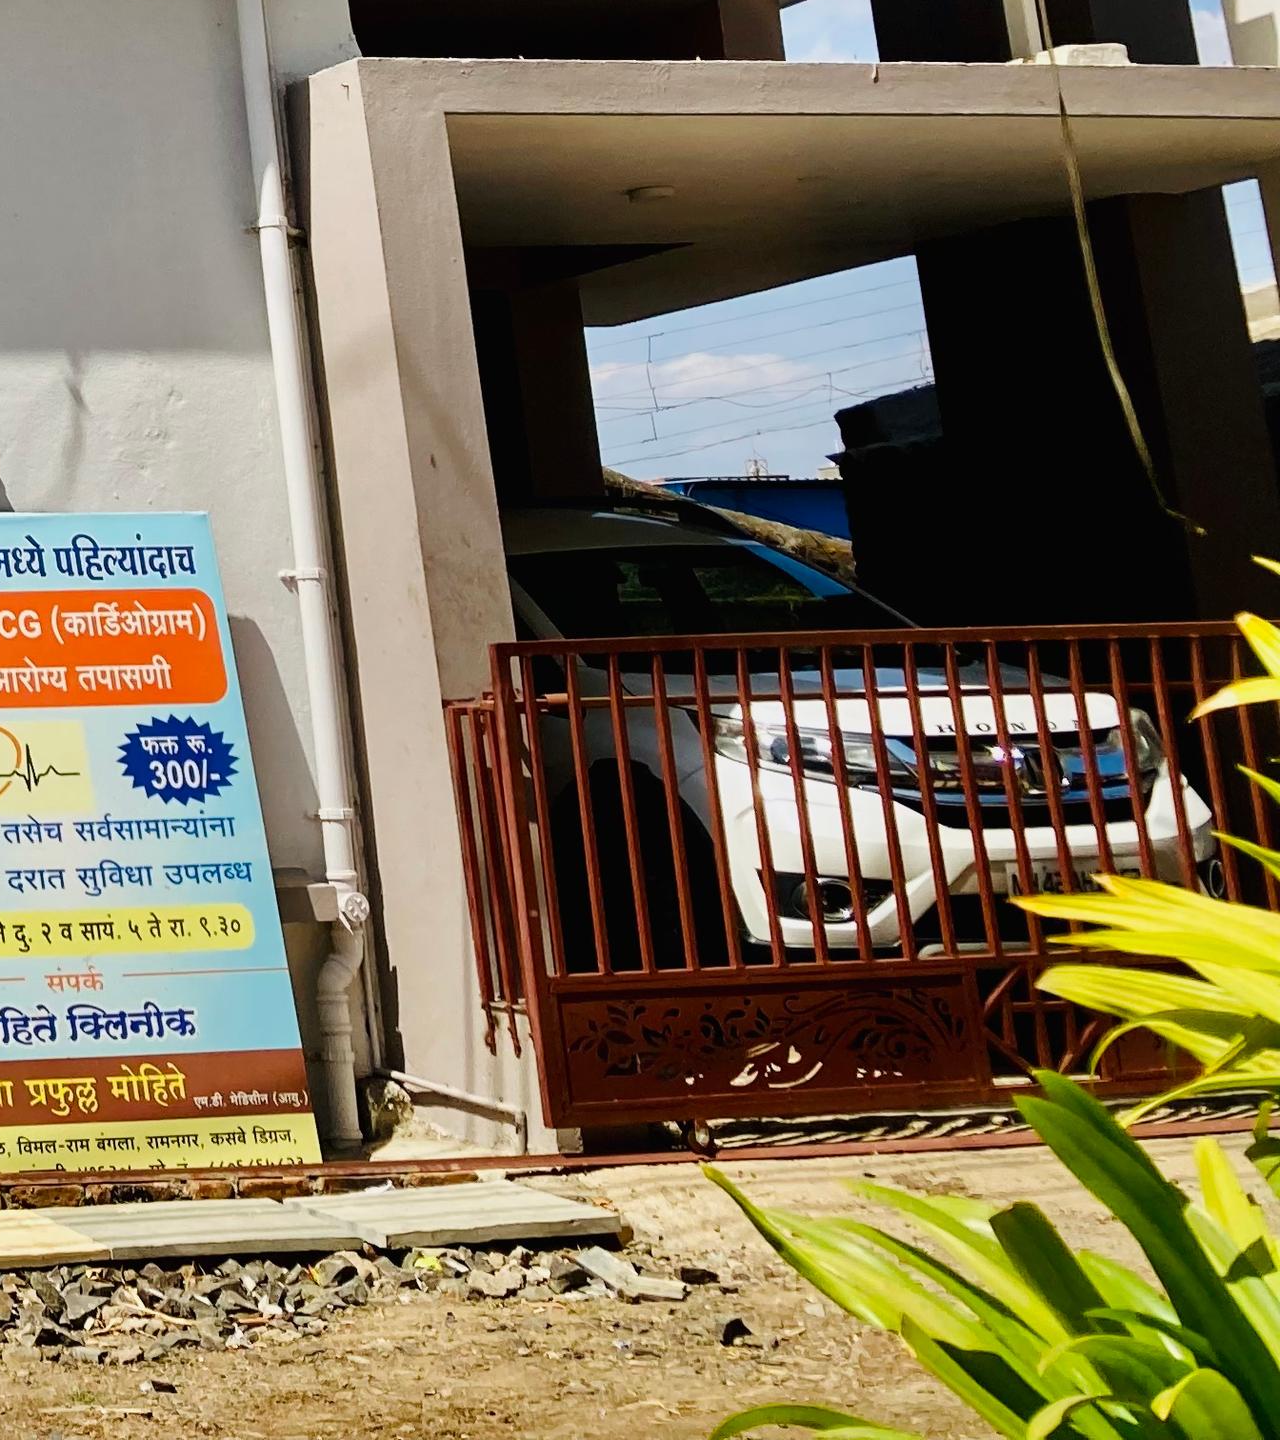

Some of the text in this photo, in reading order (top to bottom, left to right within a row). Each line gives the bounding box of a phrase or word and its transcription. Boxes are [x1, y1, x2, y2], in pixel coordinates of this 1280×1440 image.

[52, 533, 197, 580] पहिल्यांदाच
[51, 600, 206, 644] (कार्डिओग्राम)
[76, 654, 173, 691] तपासणी
[139, 735, 179, 756] फक्त
[149, 758, 221, 790] 300/-
[1, 815, 63, 845] तसेच
[73, 809, 236, 843] सर्वसामान्यांना
[5, 869, 65, 893] दरात
[76, 859, 153, 897] सुविधा
[163, 861, 253, 885] उपलब्ध
[13, 923, 33, 953] दु.
[41, 922, 52, 944] २
[60, 924, 73, 942] व
[79, 914, 121, 940] सायं.
[128, 919, 142, 942] ५
[147, 912, 162, 938] ते
[168, 918, 191, 938] रा.
[200, 916, 242, 938] ९.३०
[44, 964, 104, 992] संपर्क
[67, 1000, 196, 1042] क्लिनीक
[23, 1076, 99, 1117] प्रफुल्ल
[106, 1061, 187, 1107] मोहिते
[17, 1136, 90, 1156] विमल-राम
[146, 1133, 205, 1151] रामनगर,
[252, 1125, 297, 1146] डिग्रज,
